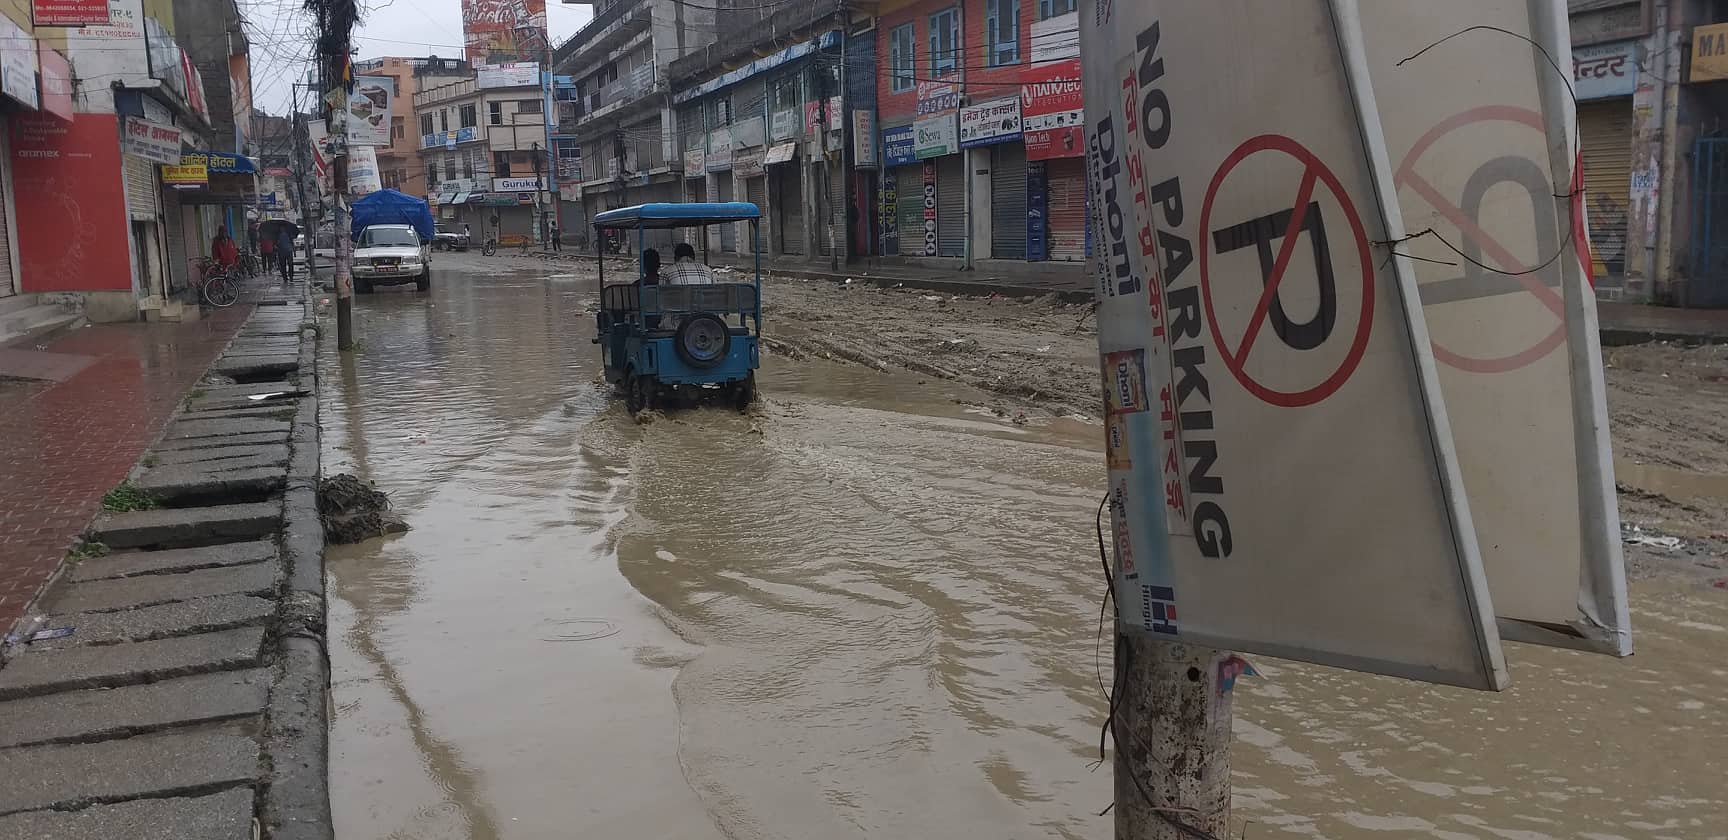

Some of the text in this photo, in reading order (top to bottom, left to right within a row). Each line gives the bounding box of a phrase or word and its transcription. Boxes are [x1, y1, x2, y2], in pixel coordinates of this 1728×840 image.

[18, 149, 60, 158] aramex
[1097, 110, 1141, 296] Dhoni
[1136, 20, 1233, 559] NO PARKING
[1213, 201, 1336, 350] P
[1118, 362, 1133, 407] Dhoni
